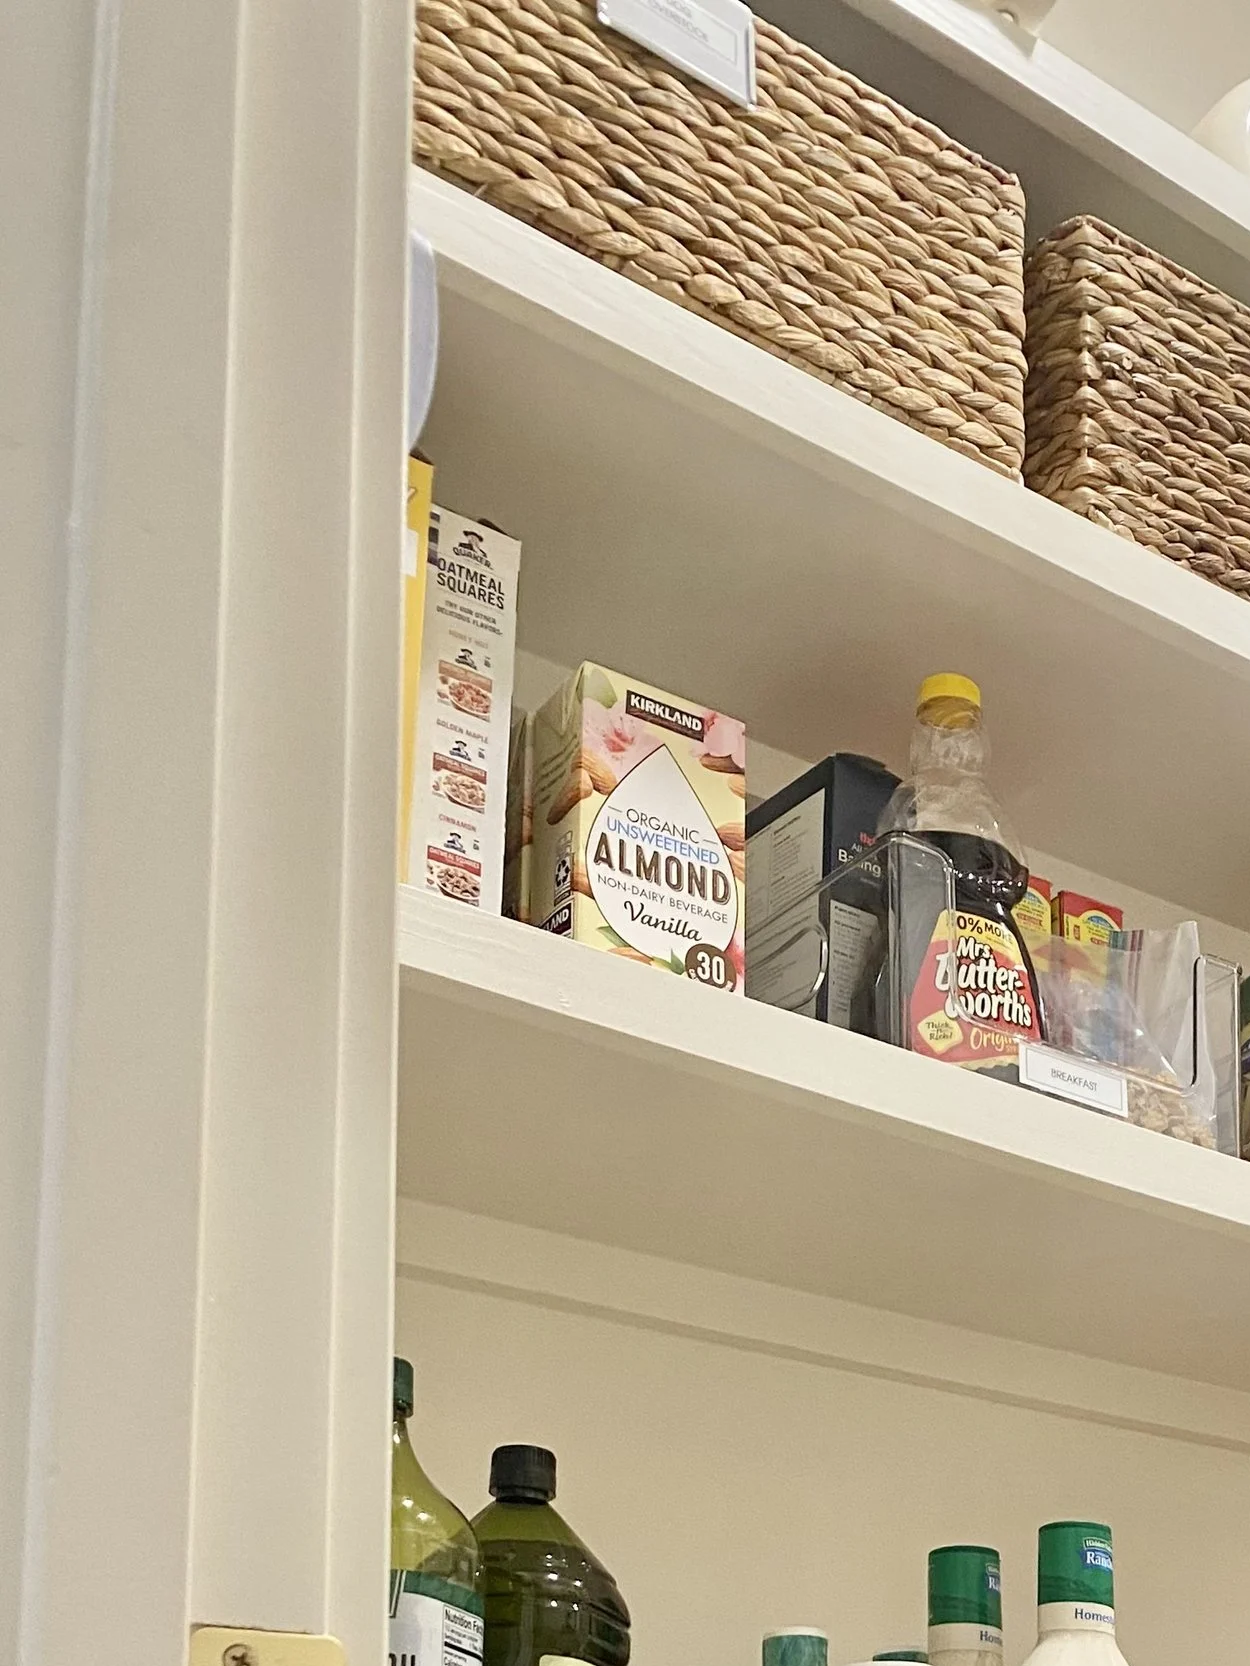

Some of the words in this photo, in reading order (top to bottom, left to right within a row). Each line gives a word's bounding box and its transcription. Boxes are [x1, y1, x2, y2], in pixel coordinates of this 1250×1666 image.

[436, 571, 504, 611] SQUARES
[437, 556, 505, 596] OATMEAL
[629, 694, 703, 733] KIRKLAND
[606, 815, 720, 866] UNSWEETENED
[626, 808, 700, 844] ORGANIC
[593, 831, 732, 906] ALMOND
[597, 874, 665, 907] NON-DAIRY
[669, 897, 729, 925] BEVERAGE
[623, 899, 703, 942] Vanilla
[984, 923, 1015, 944] MORE
[697, 952, 726, 984] 30
[956, 936, 994, 962] Mrs.
[944, 992, 1033, 1029] worth's
[1050, 1068, 1098, 1092] BREAKFAST
[444, 1608, 471, 1630] Nutrition
